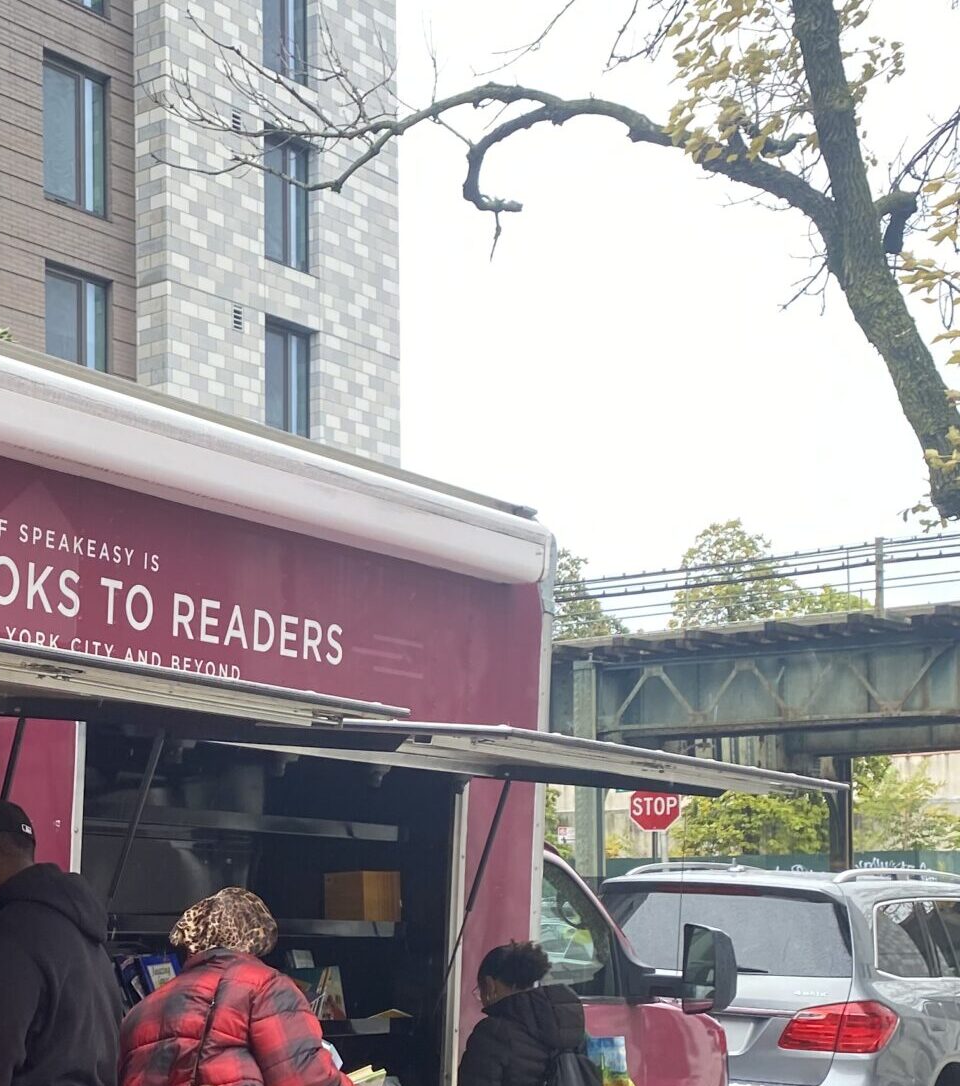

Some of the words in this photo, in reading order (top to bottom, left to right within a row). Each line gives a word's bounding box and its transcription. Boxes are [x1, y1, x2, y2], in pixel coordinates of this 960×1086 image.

[19, 524, 135, 566] SPEAKEASY
[143, 552, 160, 572] IS
[100, 576, 154, 630] TO
[173, 592, 343, 666] READERS
[6, 626, 60, 650] YORK
[71, 638, 114, 658] CITY
[124, 648, 161, 667] AND
[171, 656, 241, 681] BEYOND
[632, 796, 677, 816] STOP
